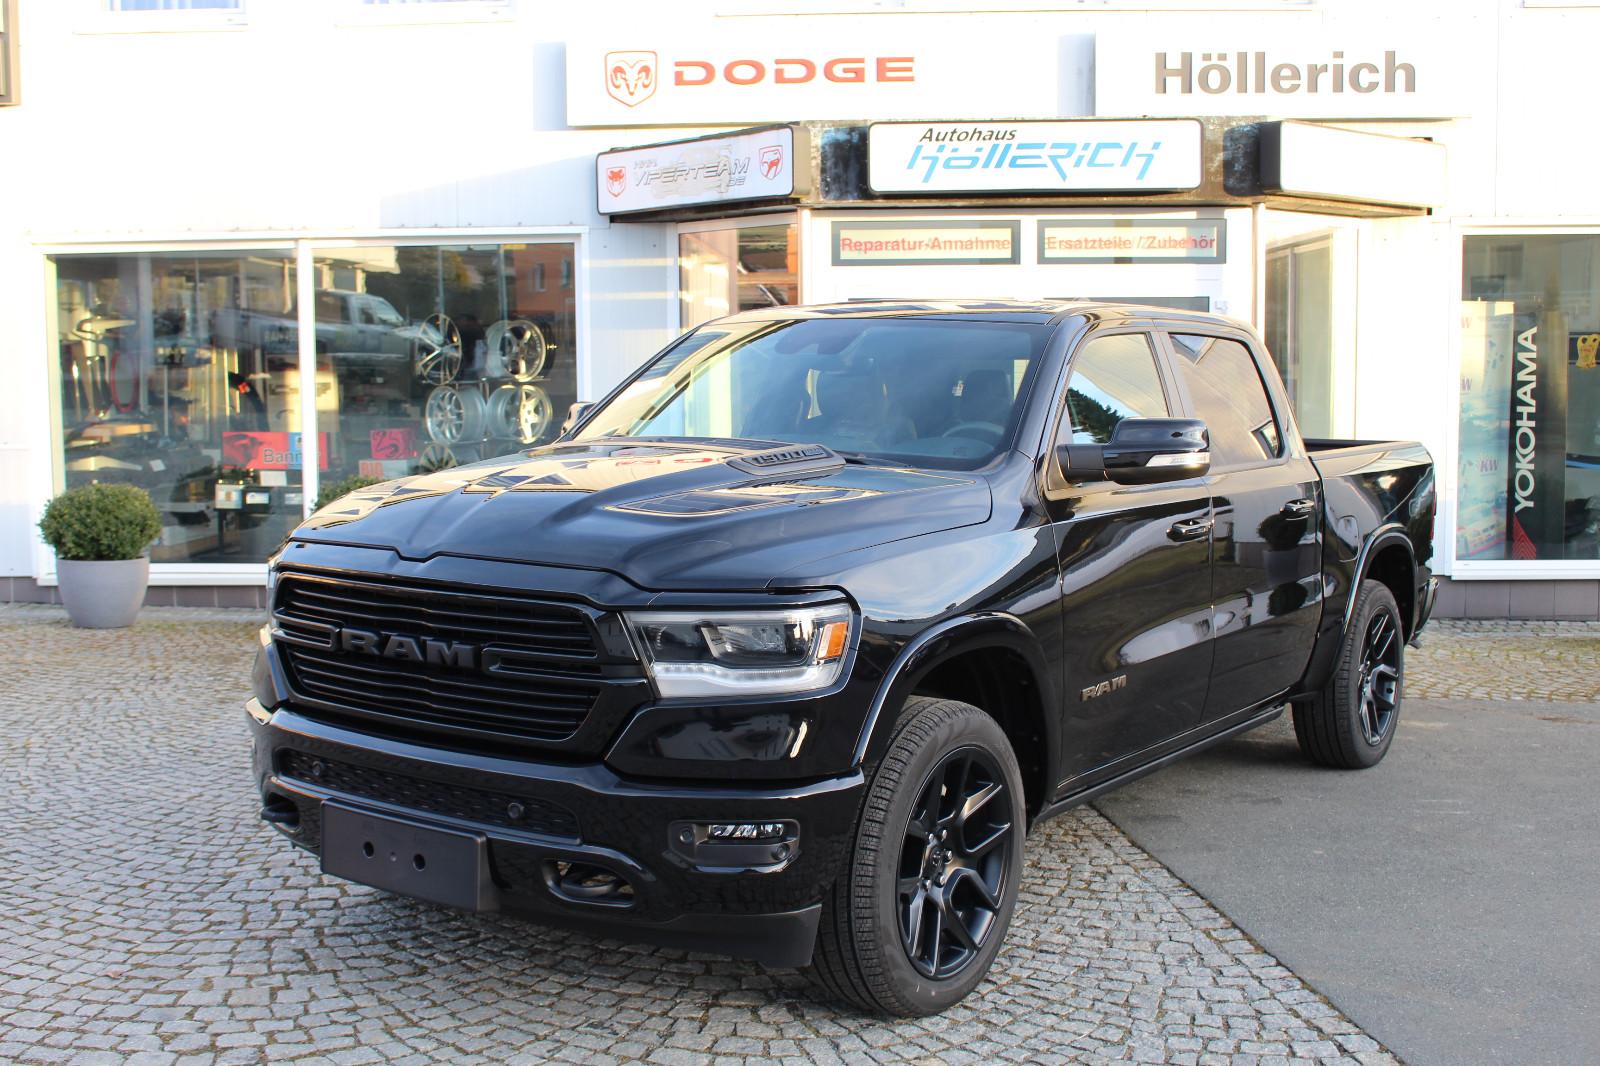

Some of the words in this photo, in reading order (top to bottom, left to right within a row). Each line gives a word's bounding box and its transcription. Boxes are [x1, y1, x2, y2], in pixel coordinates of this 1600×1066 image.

[674, 57, 915, 85] DODGE
[1155, 50, 1416, 94] Höllerich
[919, 127, 1017, 142] Autohaus
[841, 236, 1011, 255] Reparatur-Annahme
[1514, 325, 1538, 513] YOKOHAMA
[341, 628, 475, 667] RAM
[1080, 674, 1127, 702] RAM
